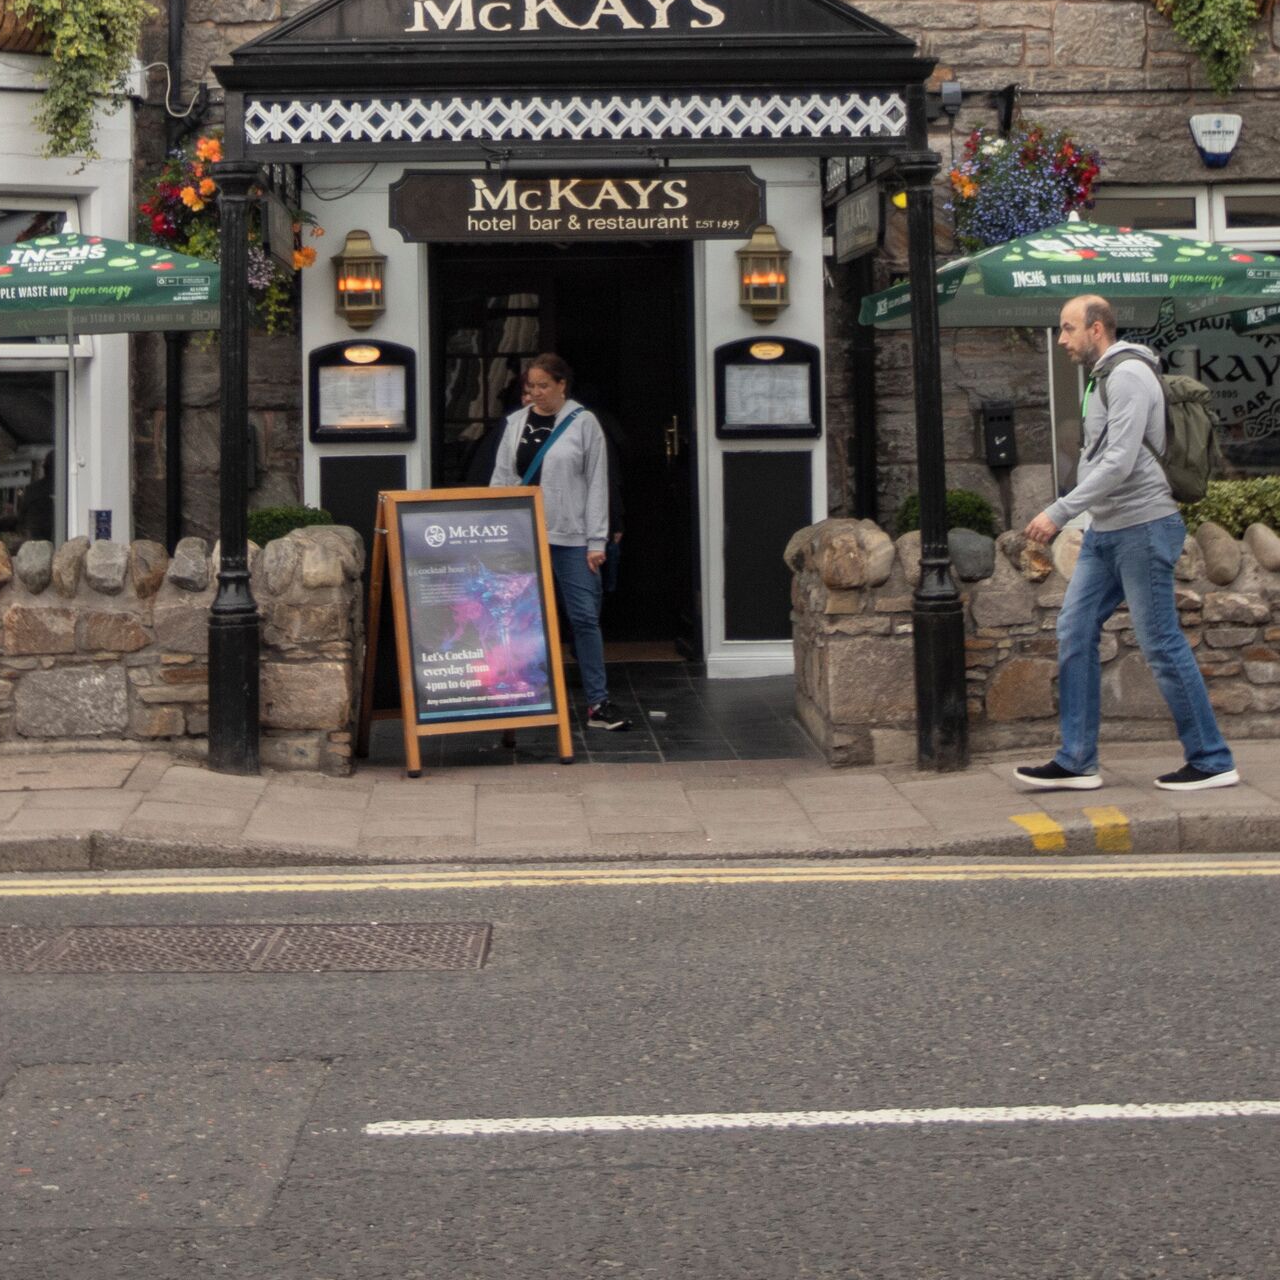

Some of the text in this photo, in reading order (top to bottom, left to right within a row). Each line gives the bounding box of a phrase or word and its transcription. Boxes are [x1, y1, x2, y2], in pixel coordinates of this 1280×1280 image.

[468, 178, 688, 211] McKAYS
[468, 215, 516, 231] hotel
[529, 215, 562, 231] bar
[567, 216, 580, 231] &
[587, 214, 689, 231] restaurant
[696, 220, 717, 229] EST
[27, 265, 73, 273] CIDER
[1050, 275, 1061, 284] WE
[1063, 274, 1081, 284] TURN
[1083, 273, 1095, 284] ALL
[1097, 272, 1121, 284] APPLE
[1122, 272, 1150, 283] WASTE
[1152, 274, 1168, 283] INTO
[1169, 274, 1194, 288] green
[1195, 274, 1224, 289] energy
[18, 285, 48, 298] WASTE
[50, 286, 68, 297] INTO
[70, 286, 96, 302] green
[98, 285, 132, 300] energy
[1233, 390, 1272, 418] BAR
[449, 525, 509, 538] McKAYS
[421, 648, 484, 662] Let's Cocktail
[423, 663, 489, 677] everyday from
[425, 679, 482, 693] 4pm to 6pm
